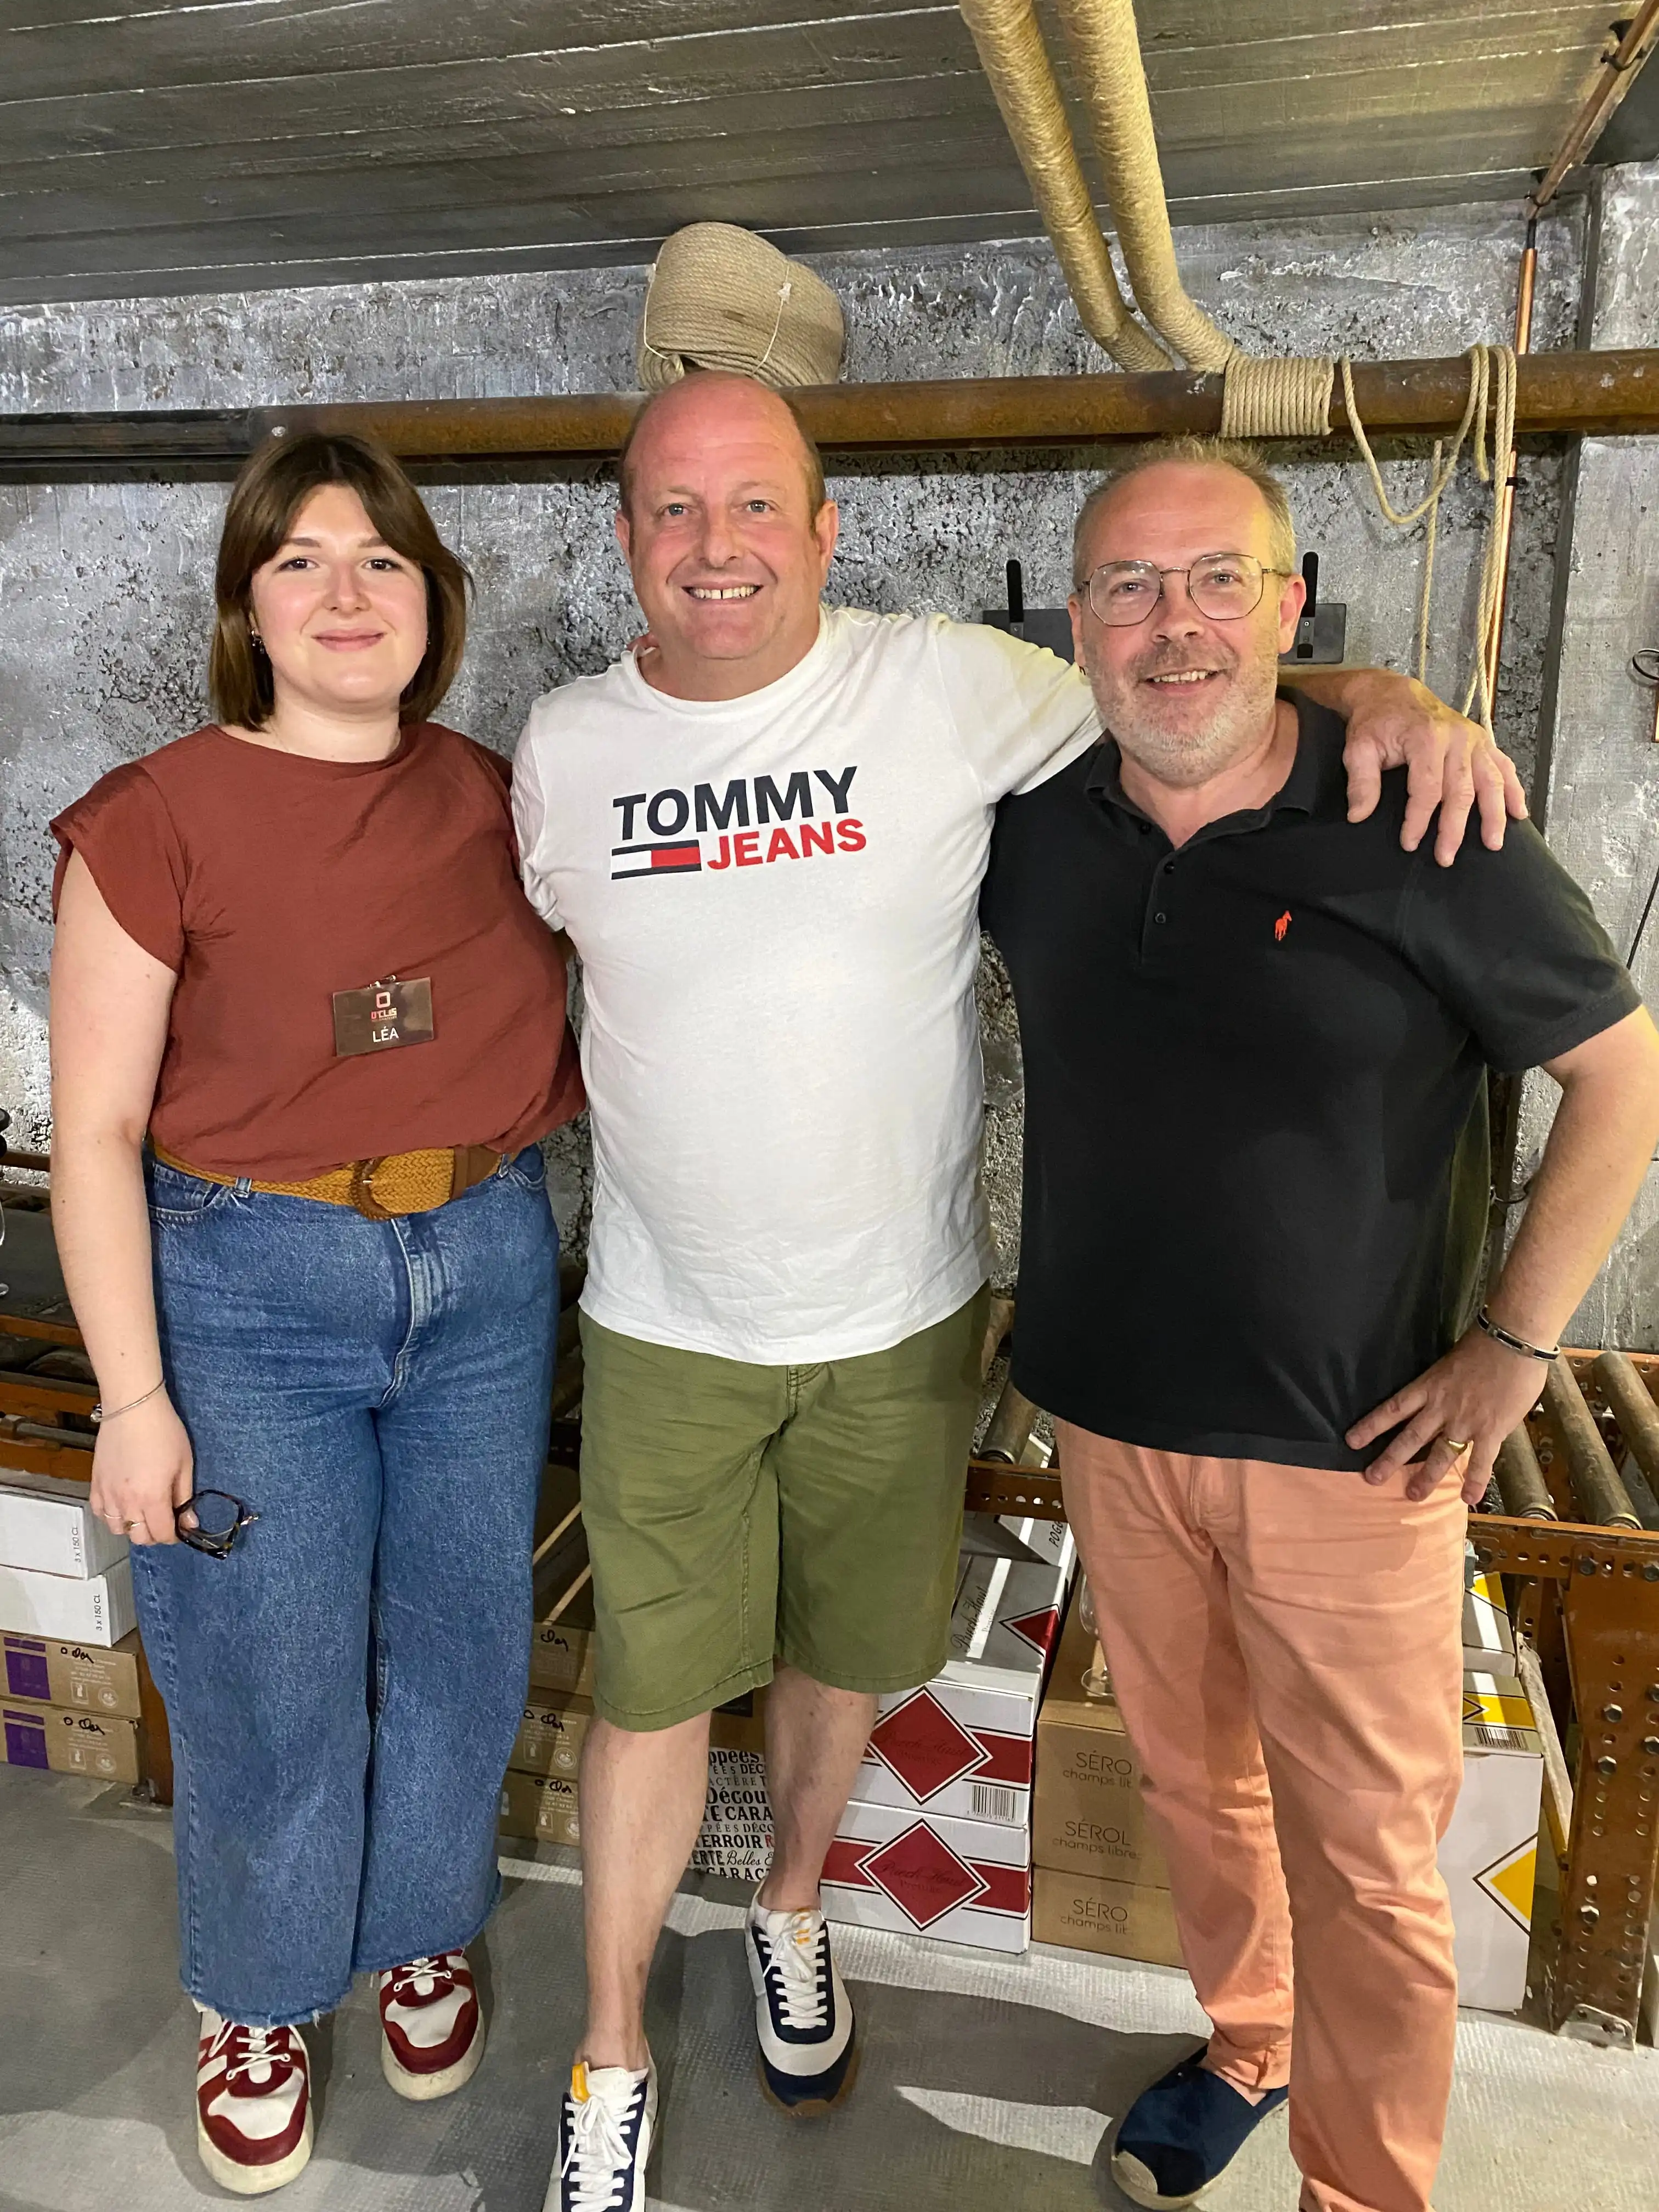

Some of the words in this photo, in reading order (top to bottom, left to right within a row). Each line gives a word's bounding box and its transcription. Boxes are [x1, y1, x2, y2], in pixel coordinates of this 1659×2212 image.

[613, 765, 858, 840] TOMMY
[707, 818, 867, 870] JEANS
[373, 1026, 399, 1043] LÉA
[1076, 1750, 1132, 1775] SÉRO
[1063, 1768, 1115, 1787] champs
[1065, 1818, 1132, 1846] SÉROL
[1052, 1836, 1104, 1854] champs
[726, 1849, 761, 1866] Belles
[1073, 1897, 1127, 1922] SÉRO
[1060, 1914, 1111, 1932] champs
